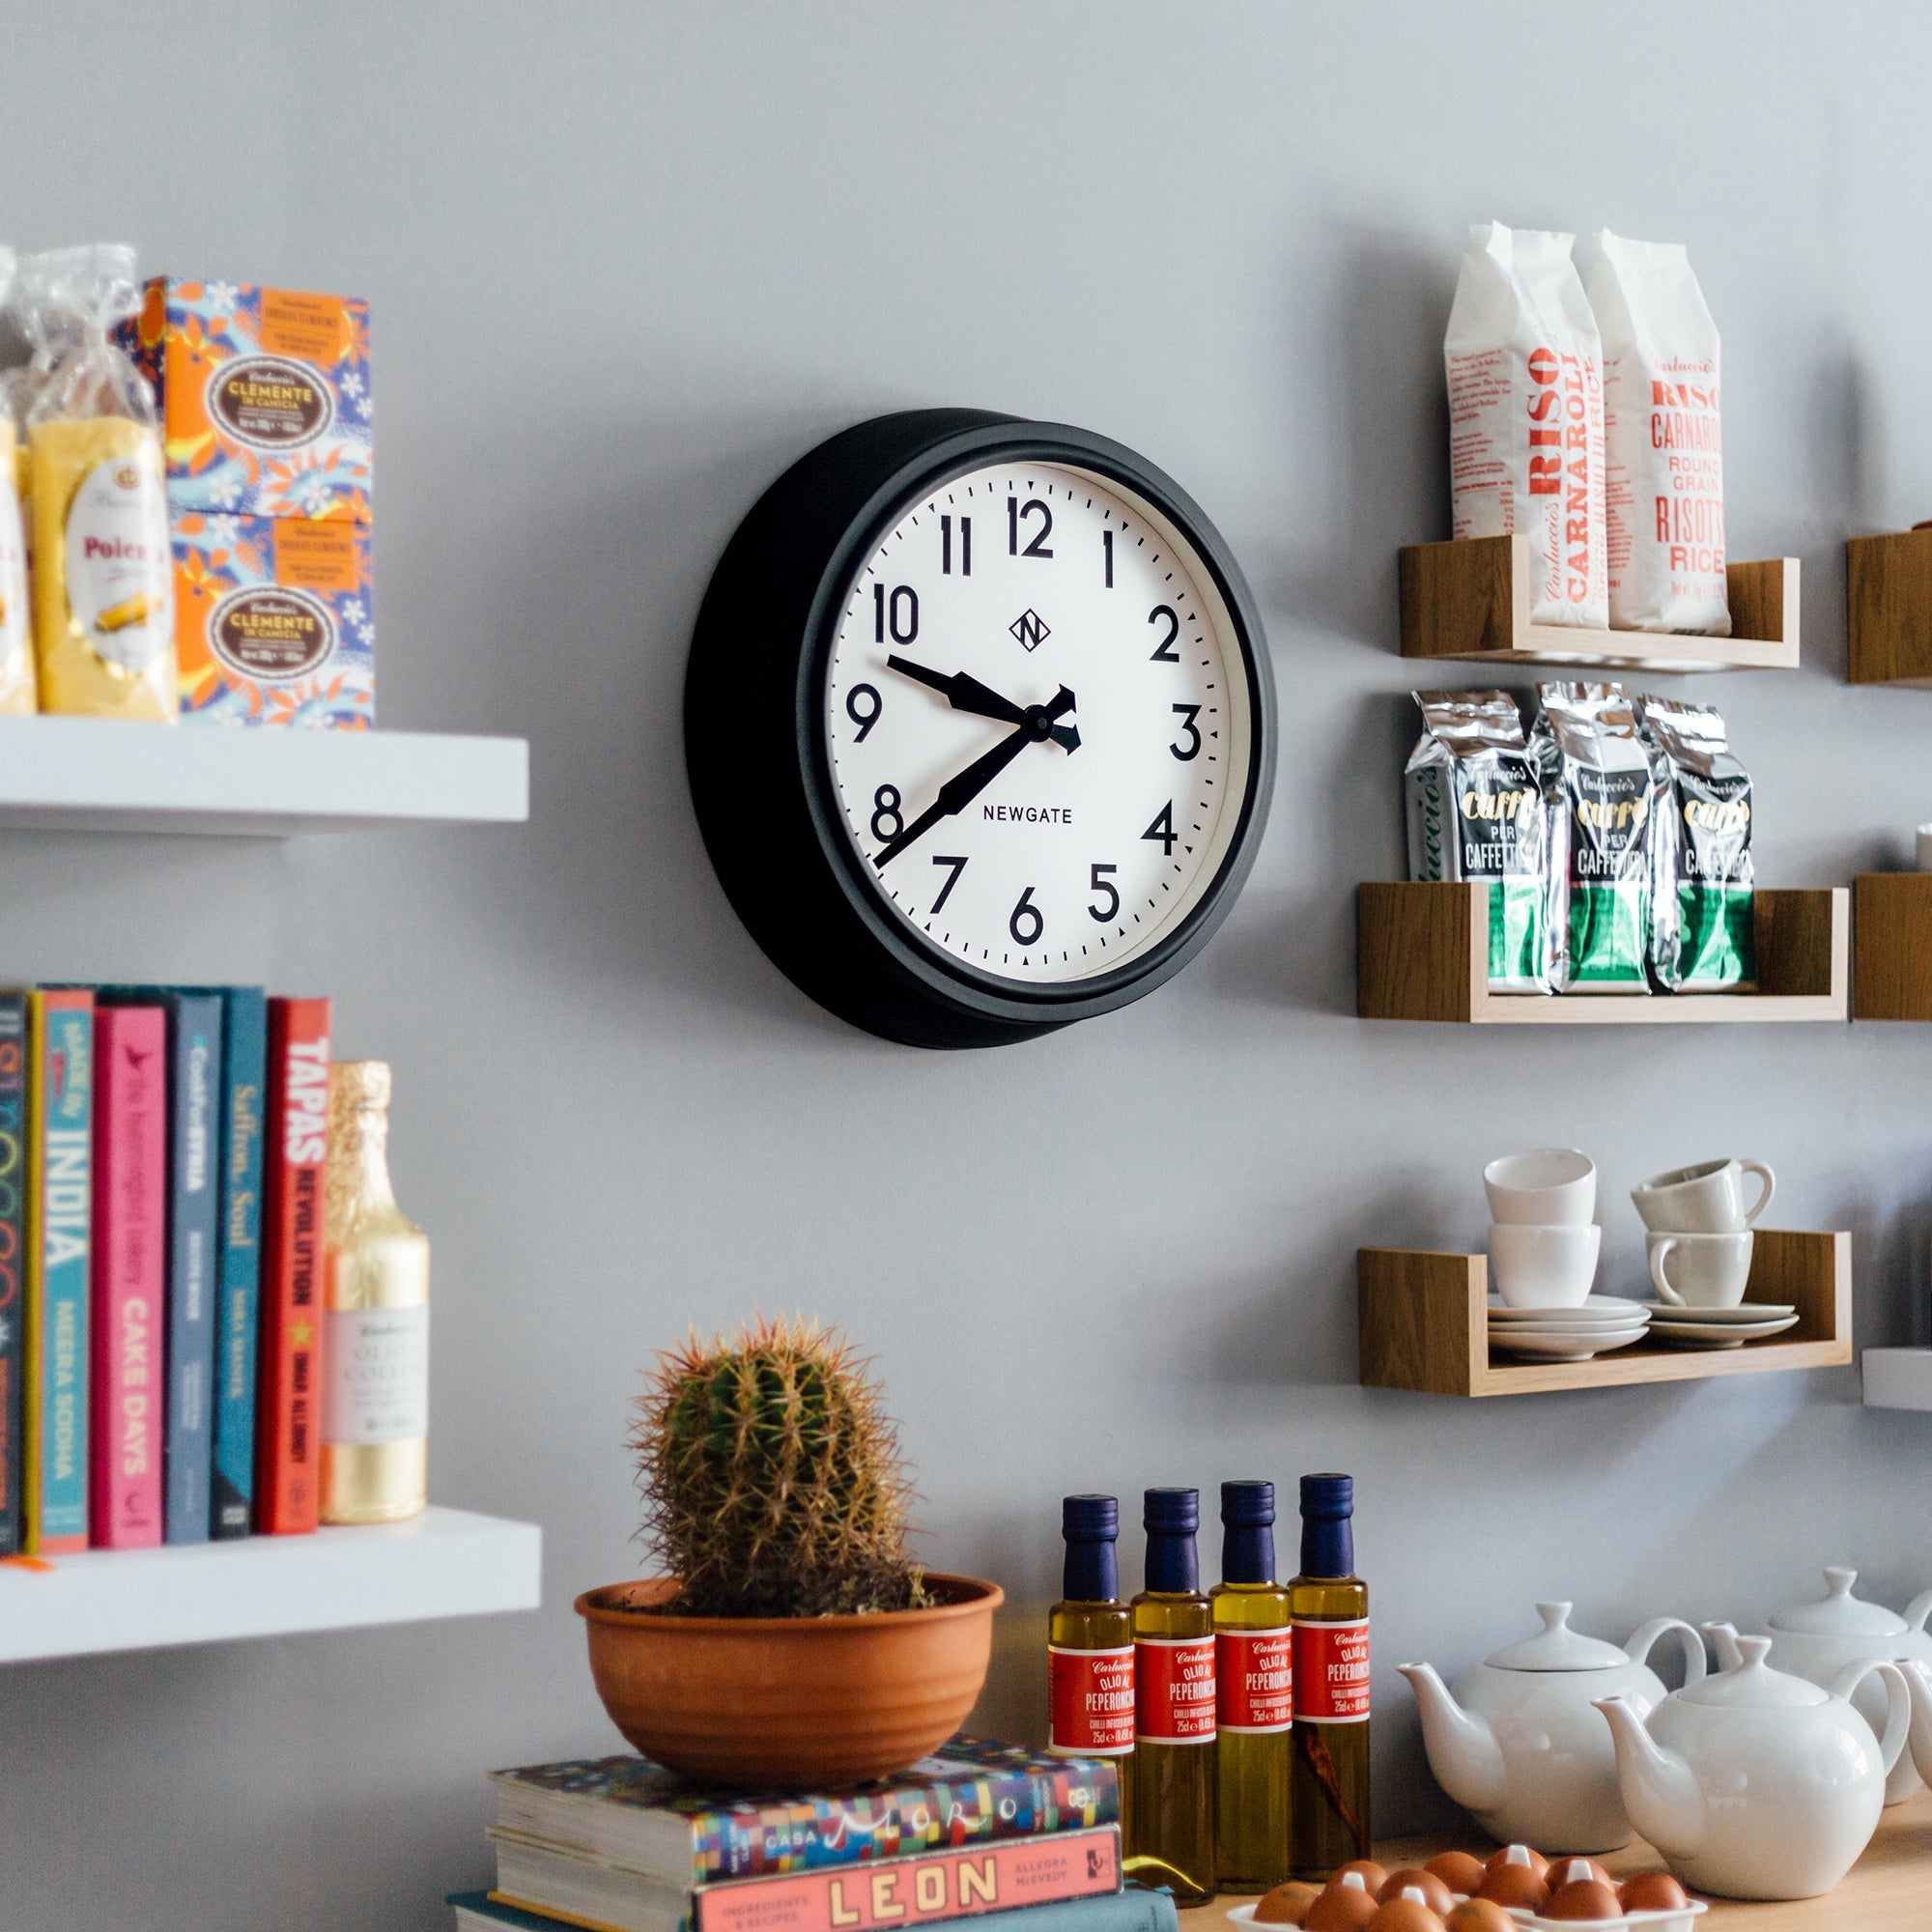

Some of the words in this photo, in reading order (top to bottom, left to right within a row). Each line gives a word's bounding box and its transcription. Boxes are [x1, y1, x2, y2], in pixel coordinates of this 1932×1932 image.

[228, 381, 313, 403] CLEMENTE
[1527, 347, 1561, 497] RISO
[1561, 351, 1589, 604] CARNAROLI
[1668, 455, 1719, 475] ROUND
[1673, 475, 1719, 494] GRAIN
[941, 515, 972, 577] 11
[1008, 497, 1054, 558] 12
[1543, 500, 1561, 603] Carluccio's
[1102, 530, 1114, 588] 1
[1670, 546, 1724, 575] RICE
[230, 612, 314, 632] CLEMENTE
[873, 583, 919, 645] 10
[1148, 605, 1179, 663] 2
[846, 683, 883, 743] 9
[1169, 703, 1202, 761] 3
[870, 783, 904, 844] 8
[982, 805, 1073, 825] NEWGATE
[1140, 799, 1179, 857] 4
[1491, 826, 1515, 839] PER
[1604, 834, 1628, 849] PER
[929, 856, 969, 914] 7
[1087, 864, 1120, 923] 5
[1009, 887, 1043, 946] 6
[285, 1037, 328, 1165] TAPAS
[45, 1129, 89, 1268] INDIA
[229, 1190, 254, 1247] Soul
[293, 1168, 316, 1307] REVOLUTION
[55, 1300, 74, 1385] MEERA
[123, 1297, 147, 1388] CAKE
[54, 1393, 74, 1480] SODHA
[123, 1395, 146, 1476] DAYS
[1100, 1674, 1121, 1690] OLIO
[1183, 1664, 1204, 1681] OLIO
[1260, 1654, 1279, 1670] OLIO
[1341, 1646, 1360, 1662] OLIO
[766, 1831, 817, 1849] CASA
[1015, 1858, 1066, 1873] ALLEGRA
[724, 1896, 809, 1918] INGREDIENTS
[748, 1912, 799, 1929] RECIPES
[829, 1856, 999, 1927] LEON
